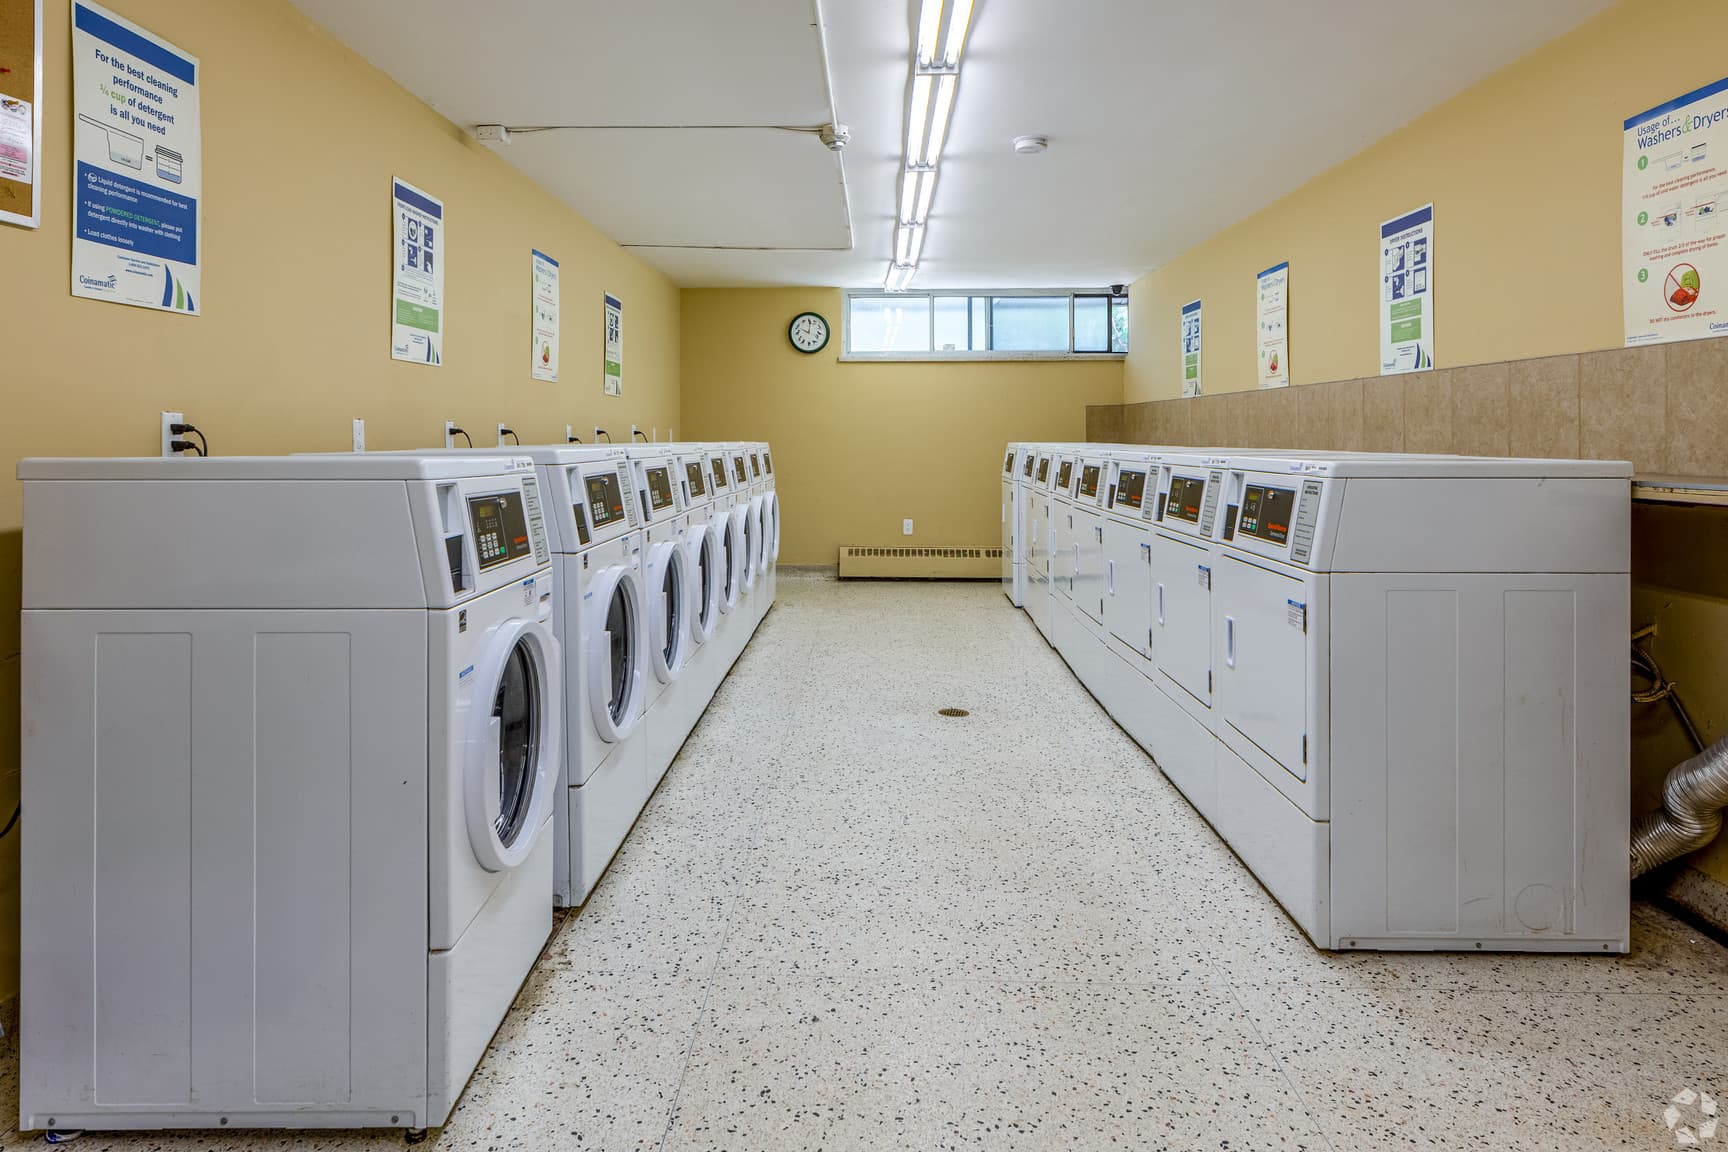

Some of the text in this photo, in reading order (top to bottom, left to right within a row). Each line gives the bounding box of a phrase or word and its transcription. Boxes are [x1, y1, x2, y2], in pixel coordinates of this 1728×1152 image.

[95, 48, 178, 98] For the best cleaning
[113, 76, 163, 104] performance
[110, 90, 126, 104] cup
[128, 98, 136, 107] of
[137, 102, 175, 124] detergent
[110, 104, 166, 135] is all you need
[1637, 121, 1659, 136] Usage
[1637, 126, 1682, 150] Washers
[88, 183, 138, 203] cleaning performance
[98, 176, 113, 186] Liquid
[113, 182, 136, 194] detergent
[141, 191, 171, 205] recommended
[88, 210, 110, 222] detergent
[110, 217, 128, 228] directly
[138, 225, 154, 233] washer
[92, 203, 105, 212] using
[105, 206, 134, 219] POWDERED
[88, 228, 134, 247] Load clothes loosely
[80, 274, 115, 289] Coinamatic
